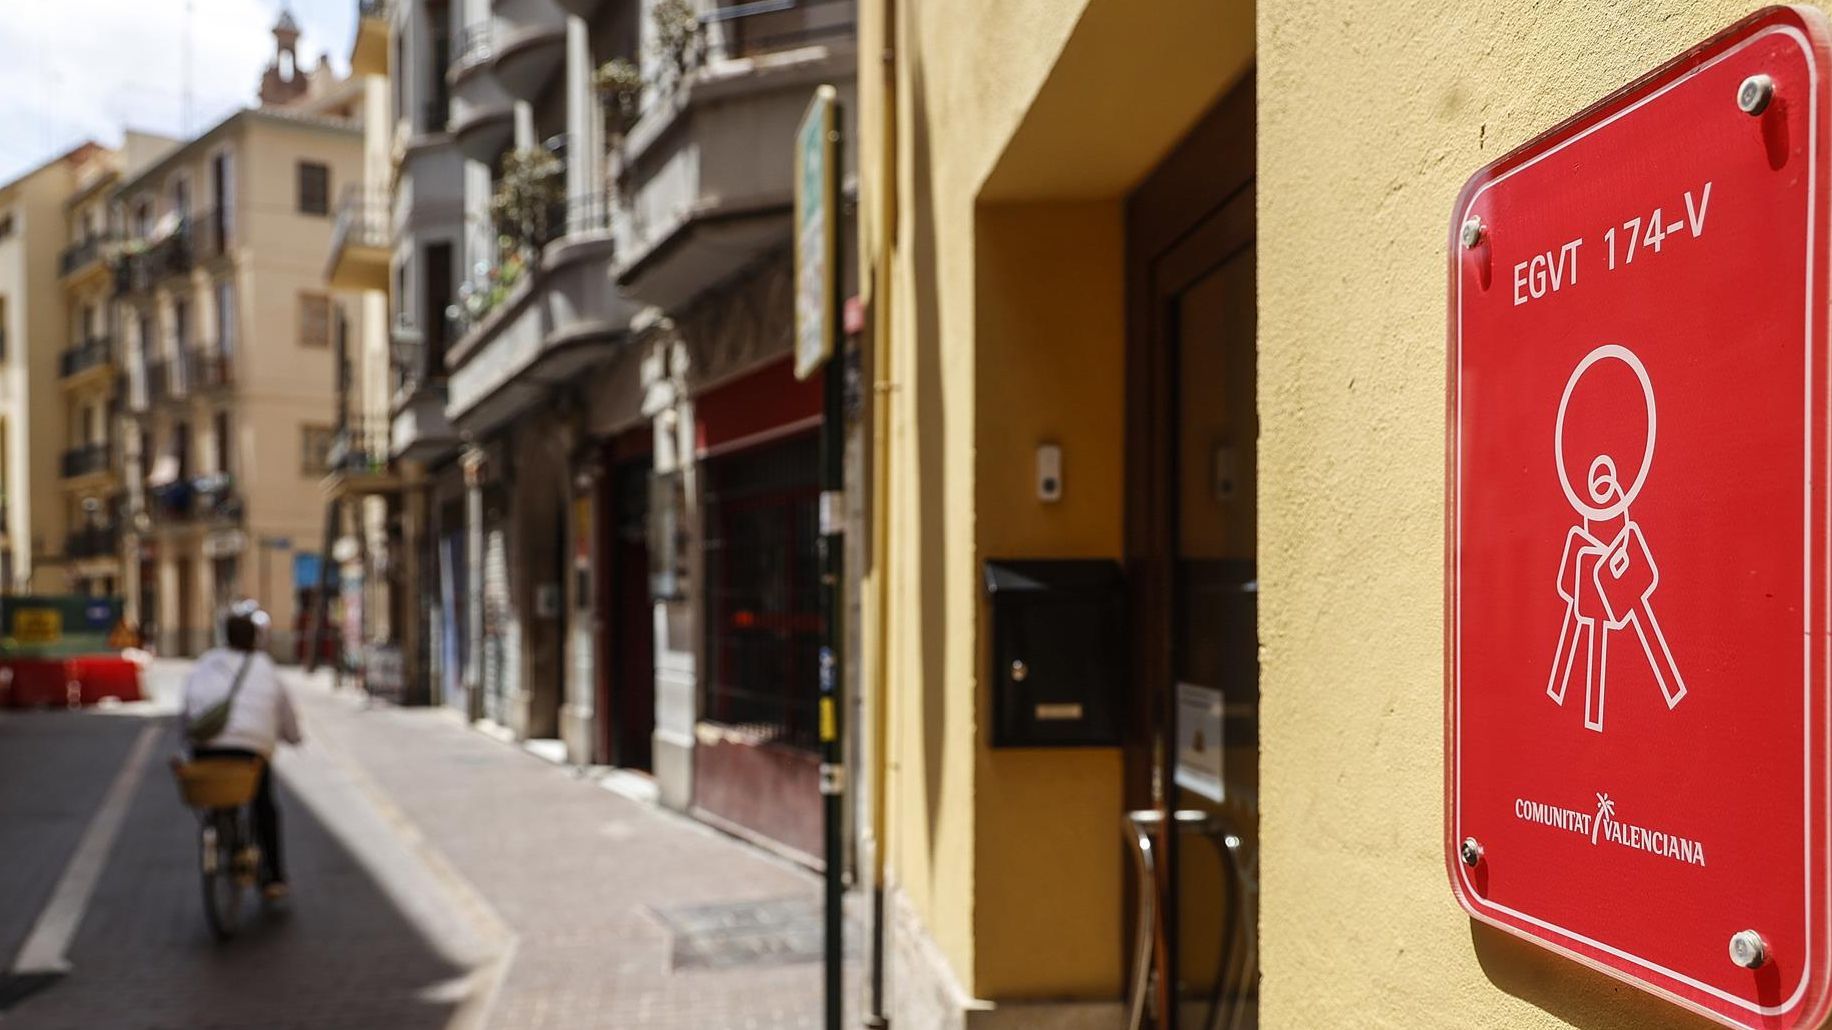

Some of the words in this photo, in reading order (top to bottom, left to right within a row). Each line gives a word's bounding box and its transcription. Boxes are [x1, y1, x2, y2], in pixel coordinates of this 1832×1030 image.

[1513, 238, 1583, 306] EGVT
[1604, 182, 1712, 270] 174-V
[1515, 798, 1592, 835] COMUNITAT
[1603, 818, 1705, 867] VALENCIANA
